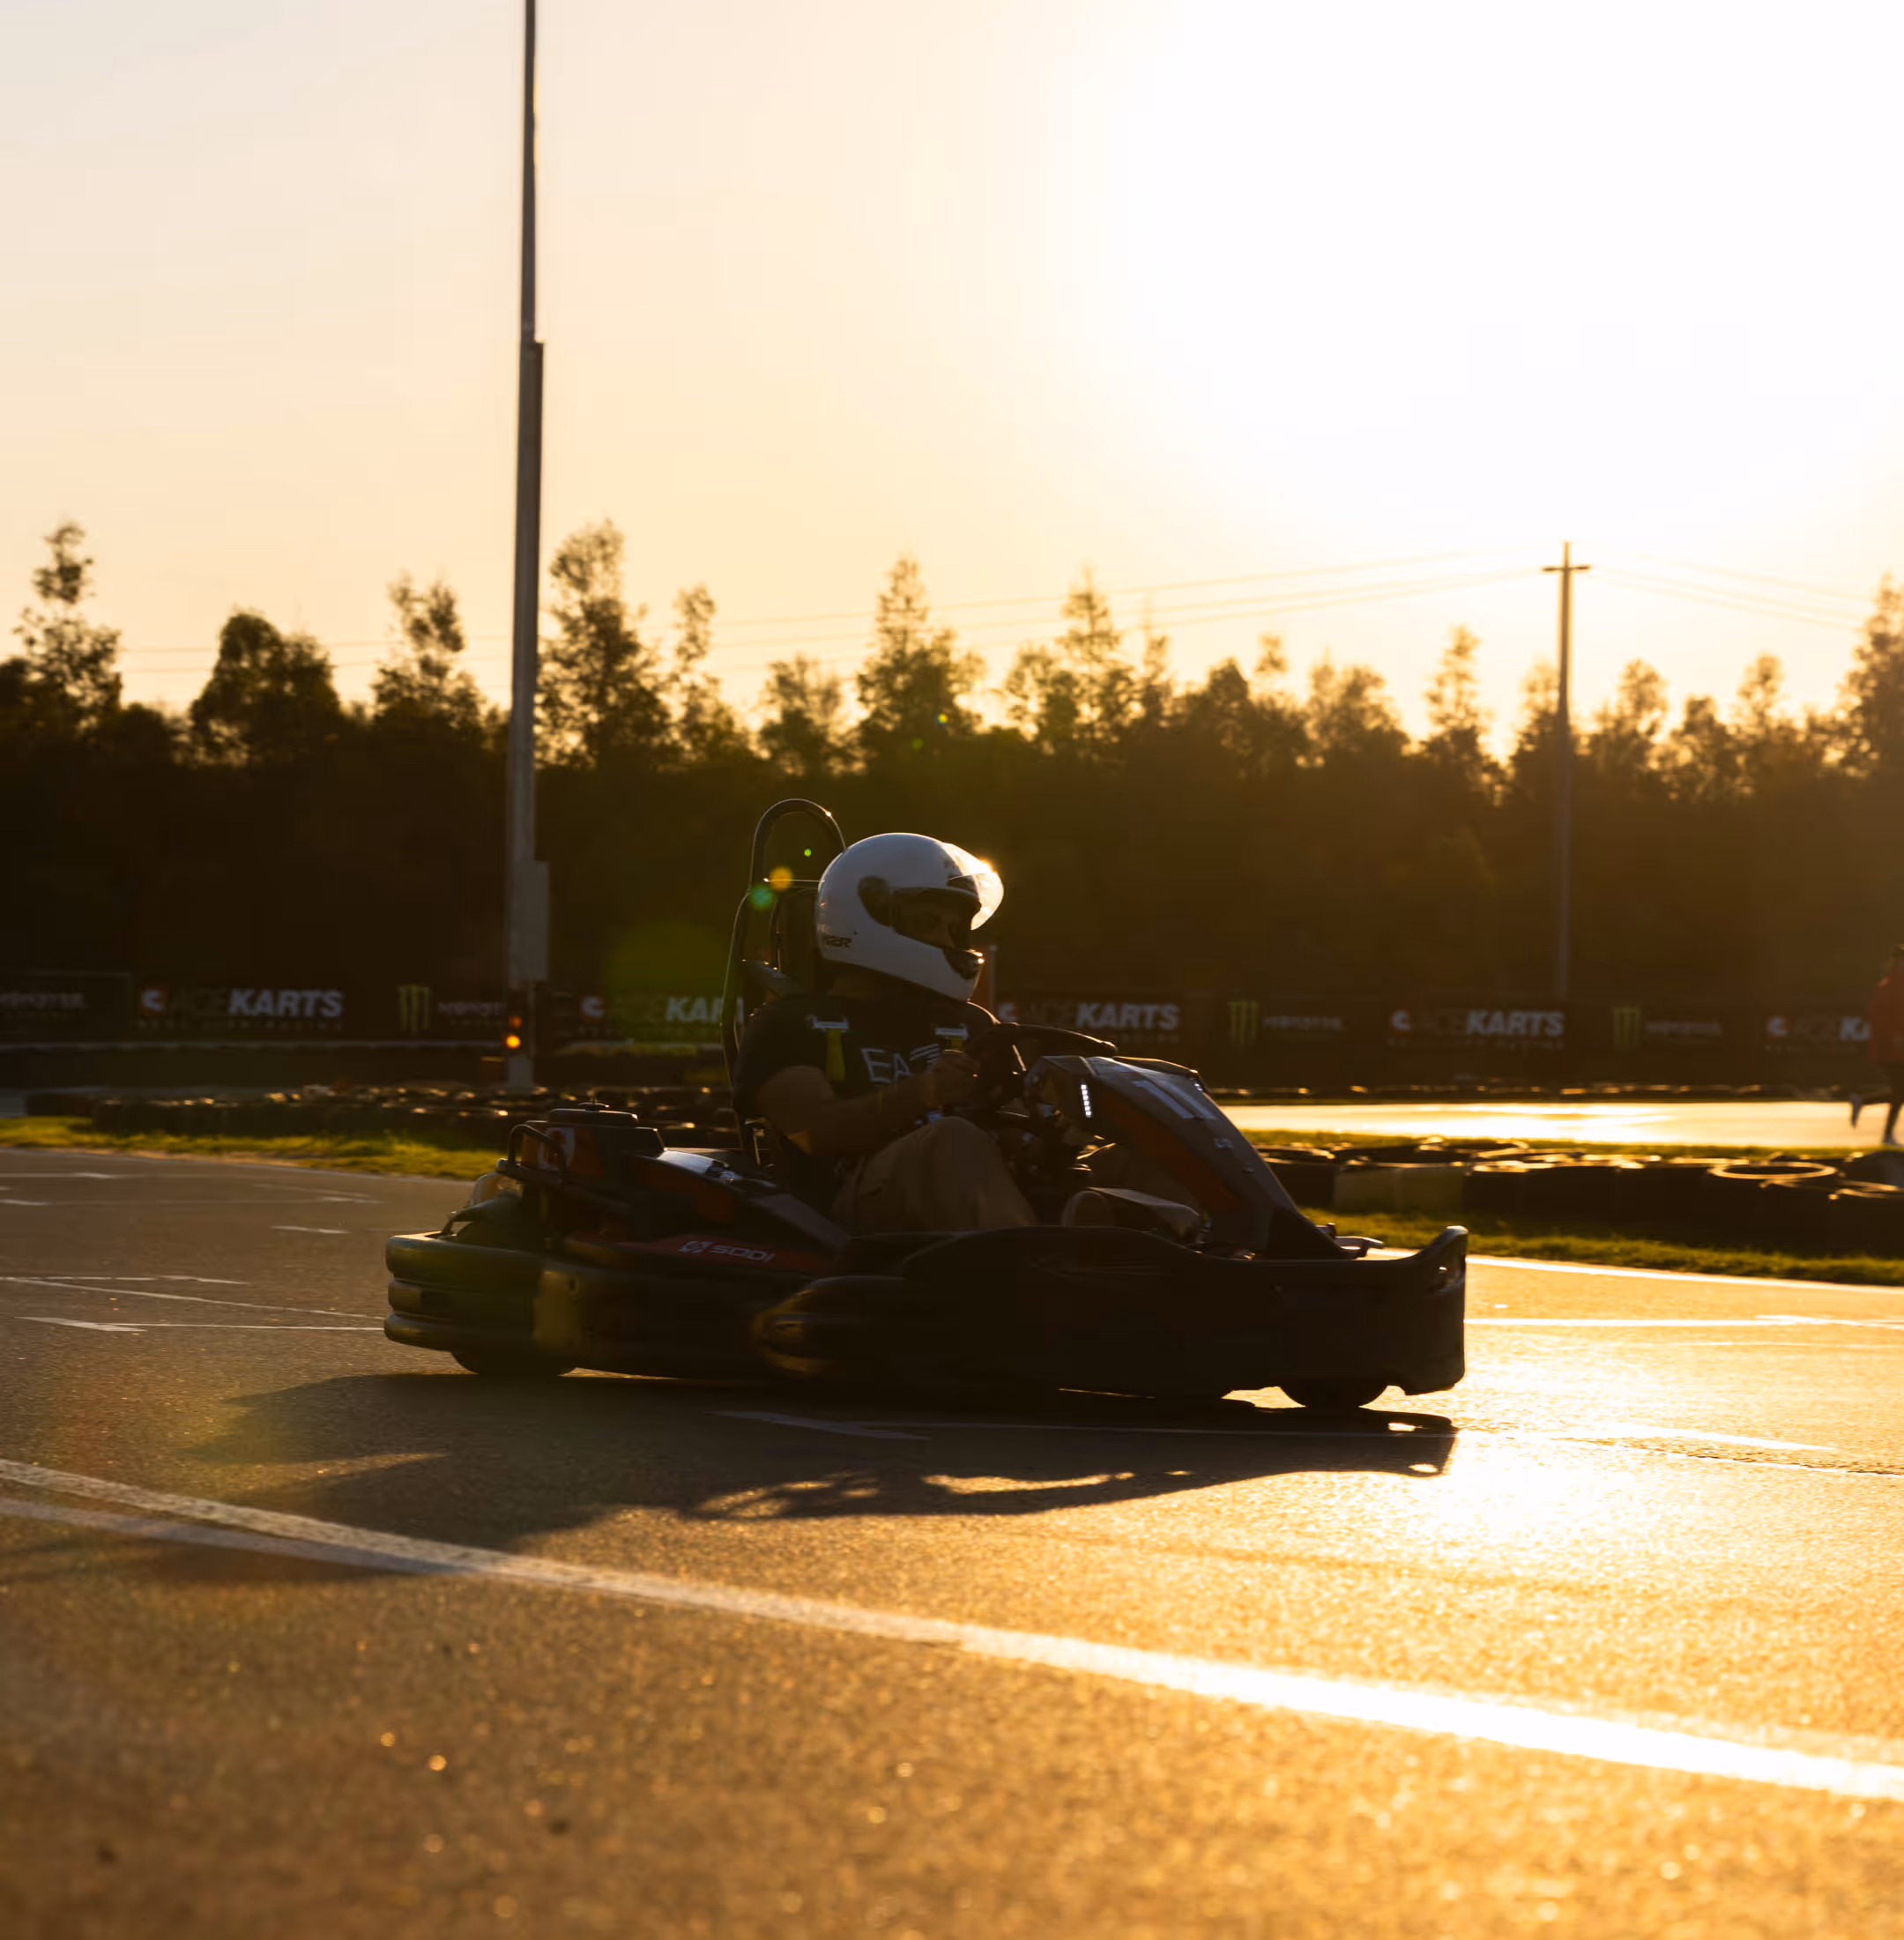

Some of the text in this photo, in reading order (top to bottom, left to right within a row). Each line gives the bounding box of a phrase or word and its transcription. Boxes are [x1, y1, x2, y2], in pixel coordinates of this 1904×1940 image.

[228, 988, 344, 1017] KARTS
[1076, 1003, 1179, 1029] KARTS
[1466, 1010, 1566, 1037] KARTS
